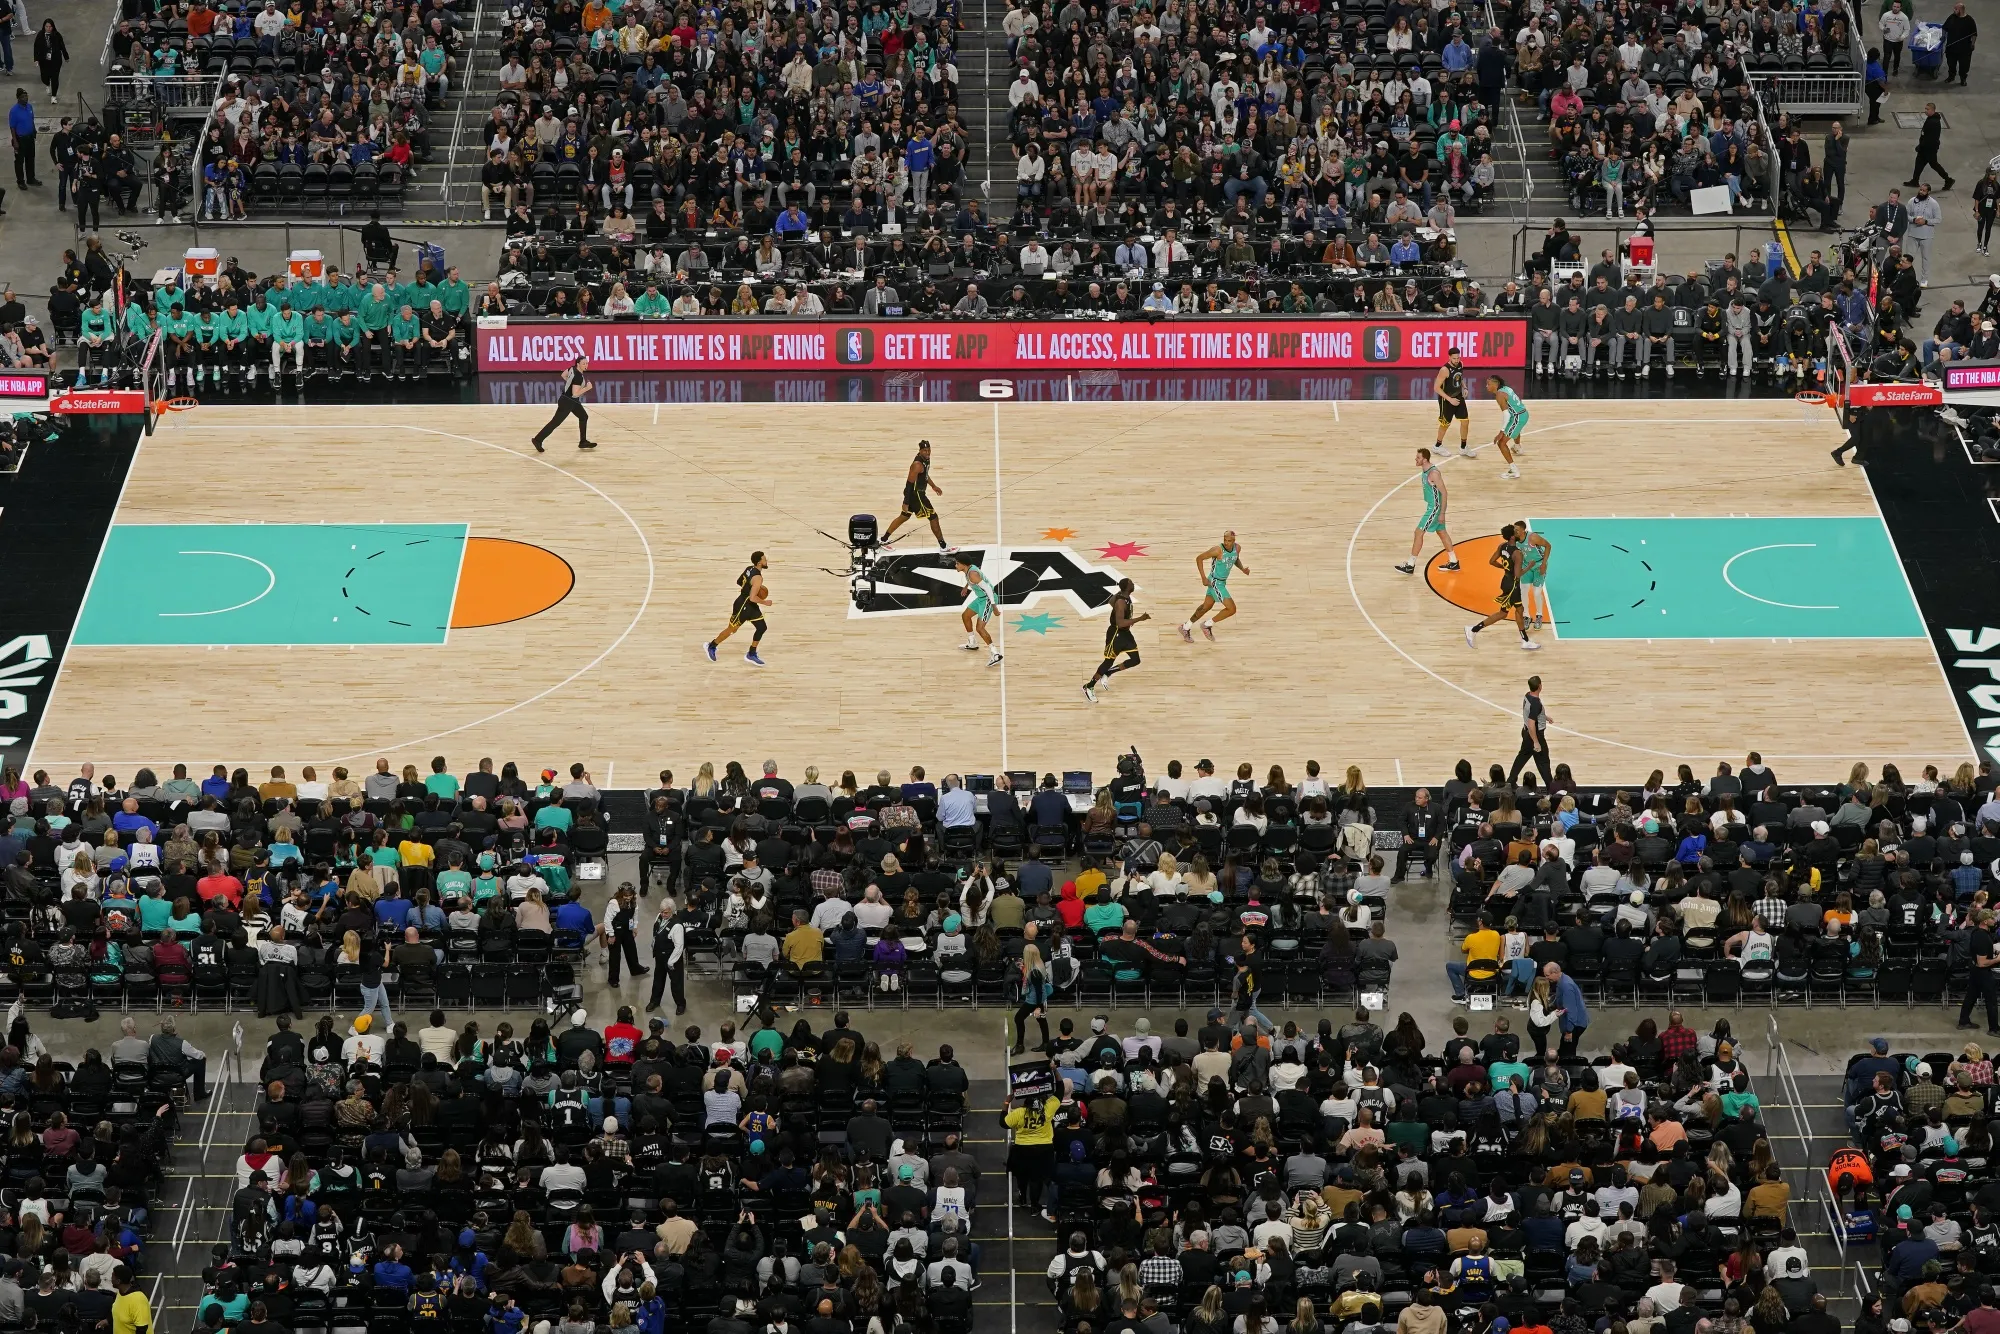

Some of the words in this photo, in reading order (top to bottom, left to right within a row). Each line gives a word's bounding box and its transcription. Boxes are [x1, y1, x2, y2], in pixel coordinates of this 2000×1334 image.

[194, 260, 205, 270] G
[488, 335, 518, 362] ALL
[521, 335, 590, 363] ACCESS,
[593, 335, 623, 361] ALL
[626, 335, 659, 361] THE
[662, 334, 704, 361] TIME
[708, 334, 725, 361] IS
[729, 334, 825, 361] HAPPENING
[884, 334, 916, 360] GET
[919, 333, 952, 360] THE
[955, 334, 988, 359] APP
[1016, 333, 1046, 359] ALL
[1049, 333, 1117, 362] ACCESS,
[1121, 333, 1151, 359] ALL
[1154, 333, 1187, 359] THE
[1190, 333, 1232, 359] TIME
[1236, 332, 1253, 359] IS
[1257, 332, 1352, 359] HAPPENING
[1411, 332, 1443, 358] GET
[1446, 332, 1479, 358] THE
[1481, 332, 1515, 357] APP
[1950, 373, 1965, 385] GET
[1965, 372, 1980, 384] THE
[1981, 371, 1996, 383] NBA
[11, 379, 27, 392] NBA
[27, 380, 43, 392] APP
[979, 379, 1013, 398] 6
[1122, 783, 1141, 792] ESPN
[1904, 910, 1916, 924] 5
[9, 953, 24, 965] 30
[1359, 1098, 1383, 1108] DUNCAN
[564, 1109, 573, 1124] 1
[752, 1123, 763, 1133] 30
[642, 1143, 659, 1152] ANTI
[1834, 1162, 1860, 1172] VENDOR
[814, 1199, 838, 1210] BRYANT
[322, 1241, 333, 1253] 9
